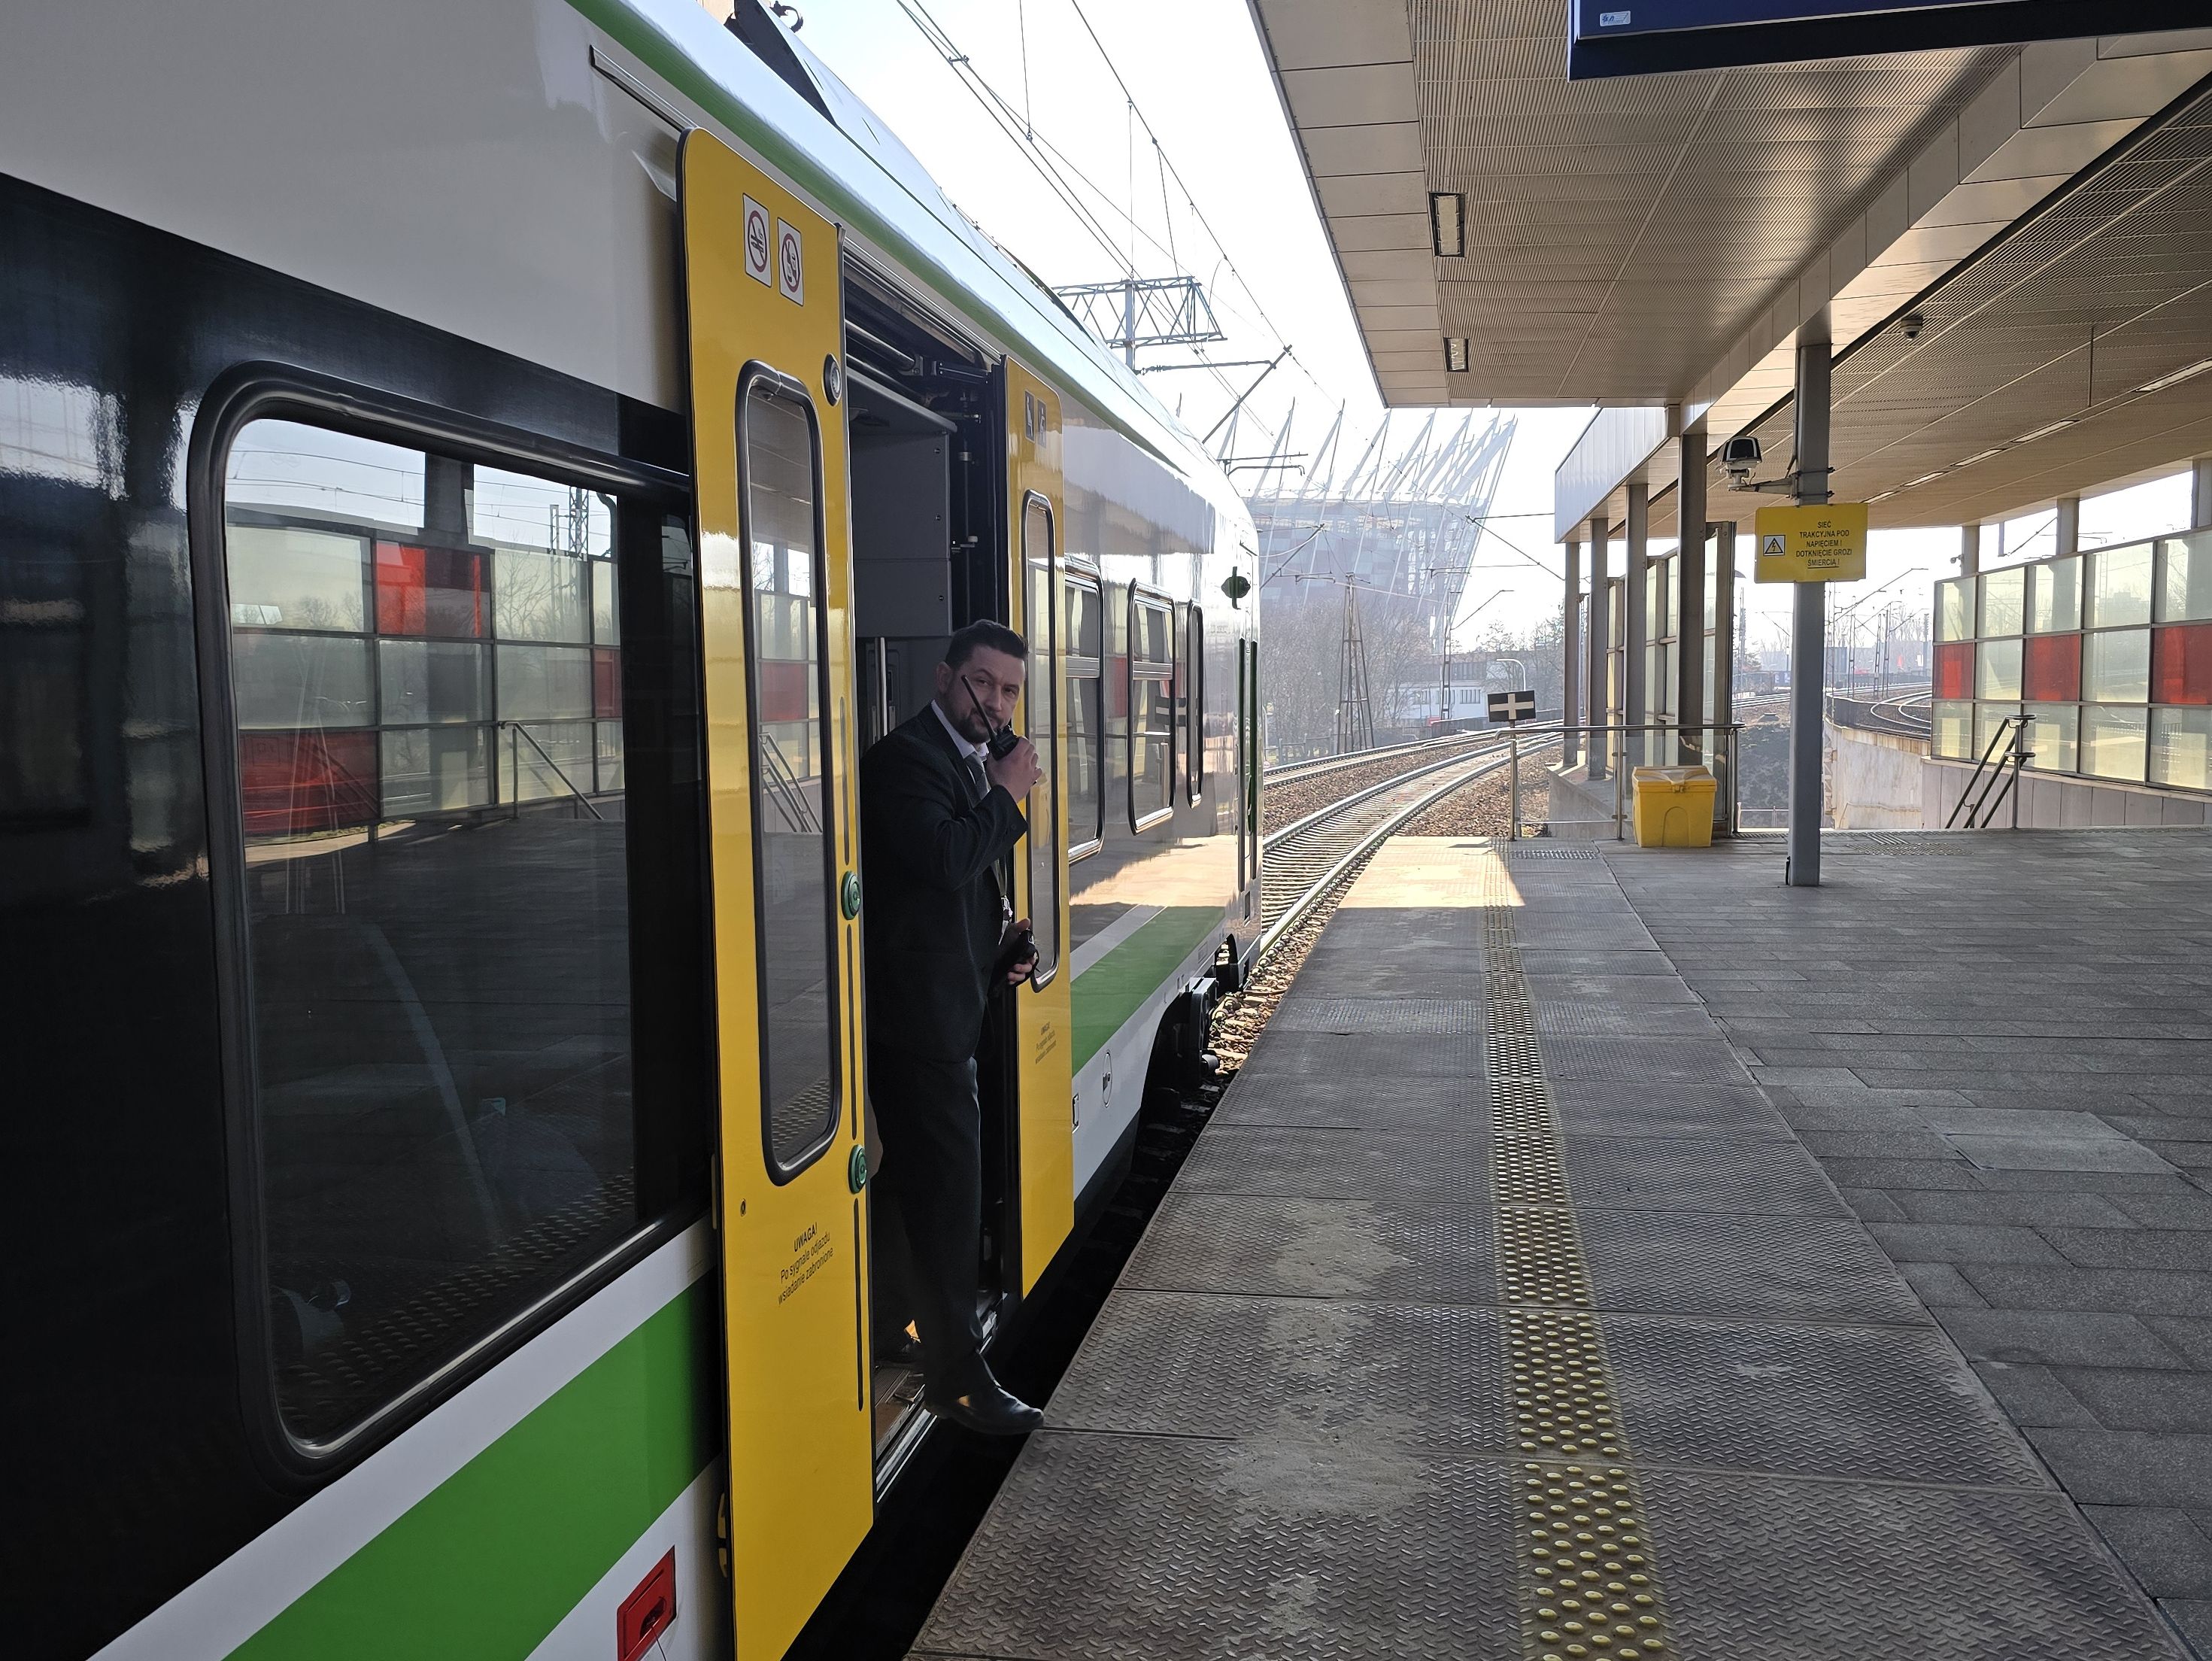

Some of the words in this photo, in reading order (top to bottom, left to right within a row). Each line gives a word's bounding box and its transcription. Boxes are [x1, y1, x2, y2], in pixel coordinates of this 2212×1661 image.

[1817, 520, 1831, 528] SIEĆ
[1799, 530, 1836, 539] TRAKCYJNA
[1806, 539, 1839, 548] NAPIĘCIEM
[1795, 549, 1832, 557] DOTKNIĘCIE
[793, 1222, 818, 1253] UWAGA!
[781, 1269, 789, 1284] Po
[790, 1250, 810, 1277] sygnale
[811, 1231, 830, 1256] odjazdu
[778, 1272, 806, 1304] wsiadanie
[806, 1247, 833, 1280] zabronione
